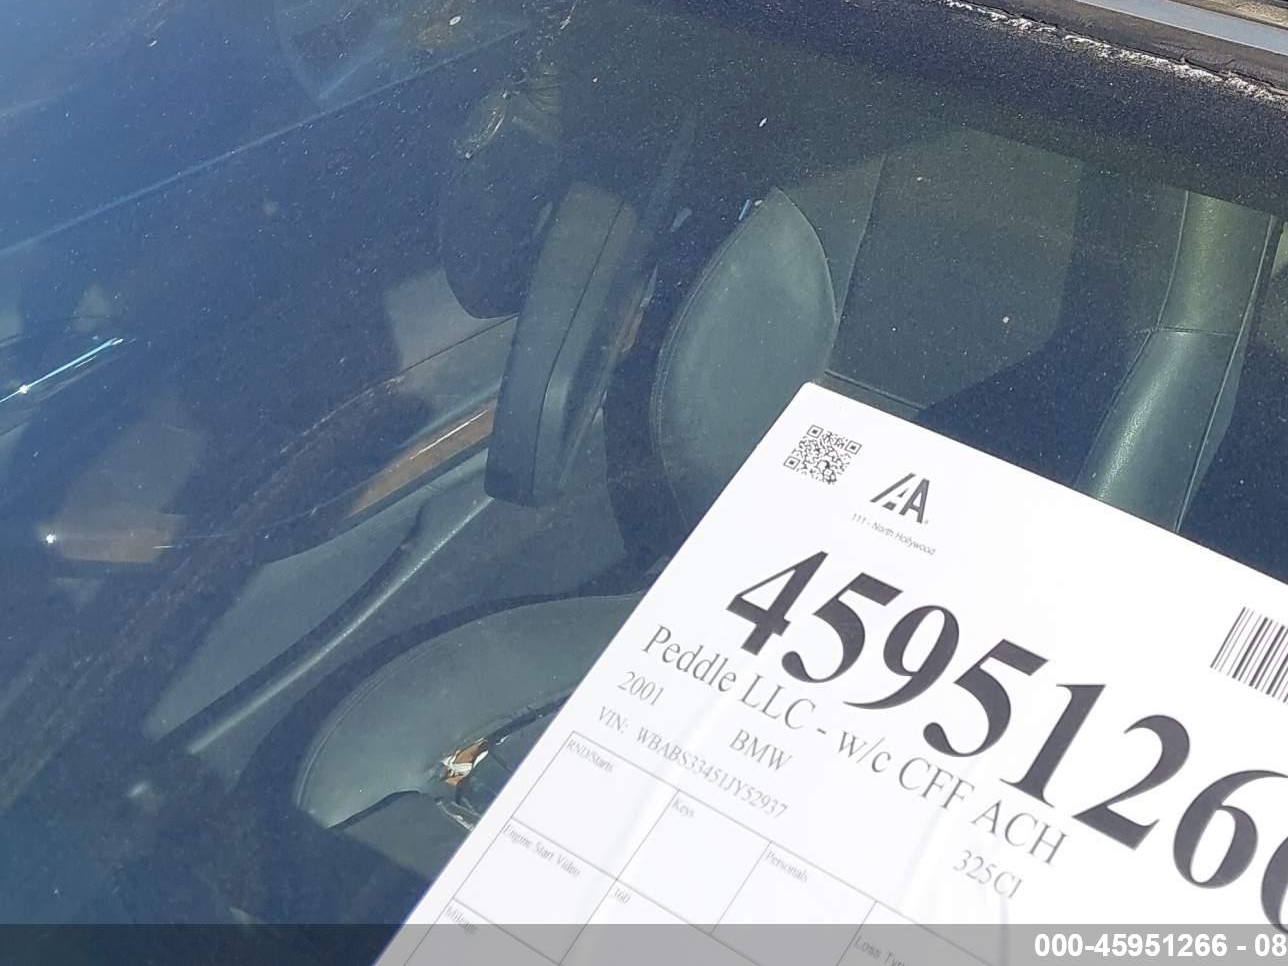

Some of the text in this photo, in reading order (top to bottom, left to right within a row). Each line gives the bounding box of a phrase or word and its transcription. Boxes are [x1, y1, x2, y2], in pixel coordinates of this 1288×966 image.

[871, 521, 894, 537] North
[894, 533, 936, 555] Hollywood
[597, 705, 788, 819] VIN: WBABS33451JY52937
[641, 625, 737, 692] Peddle
[738, 673, 816, 730] LLC
[837, 730, 891, 773] w/c
[898, 756, 975, 810] CFF
[970, 799, 1068, 865] ACH
[617, 670, 1023, 899] 2001 BMW 325CI
[671, 797, 695, 818] Keys
[764, 849, 809, 883] Personals
